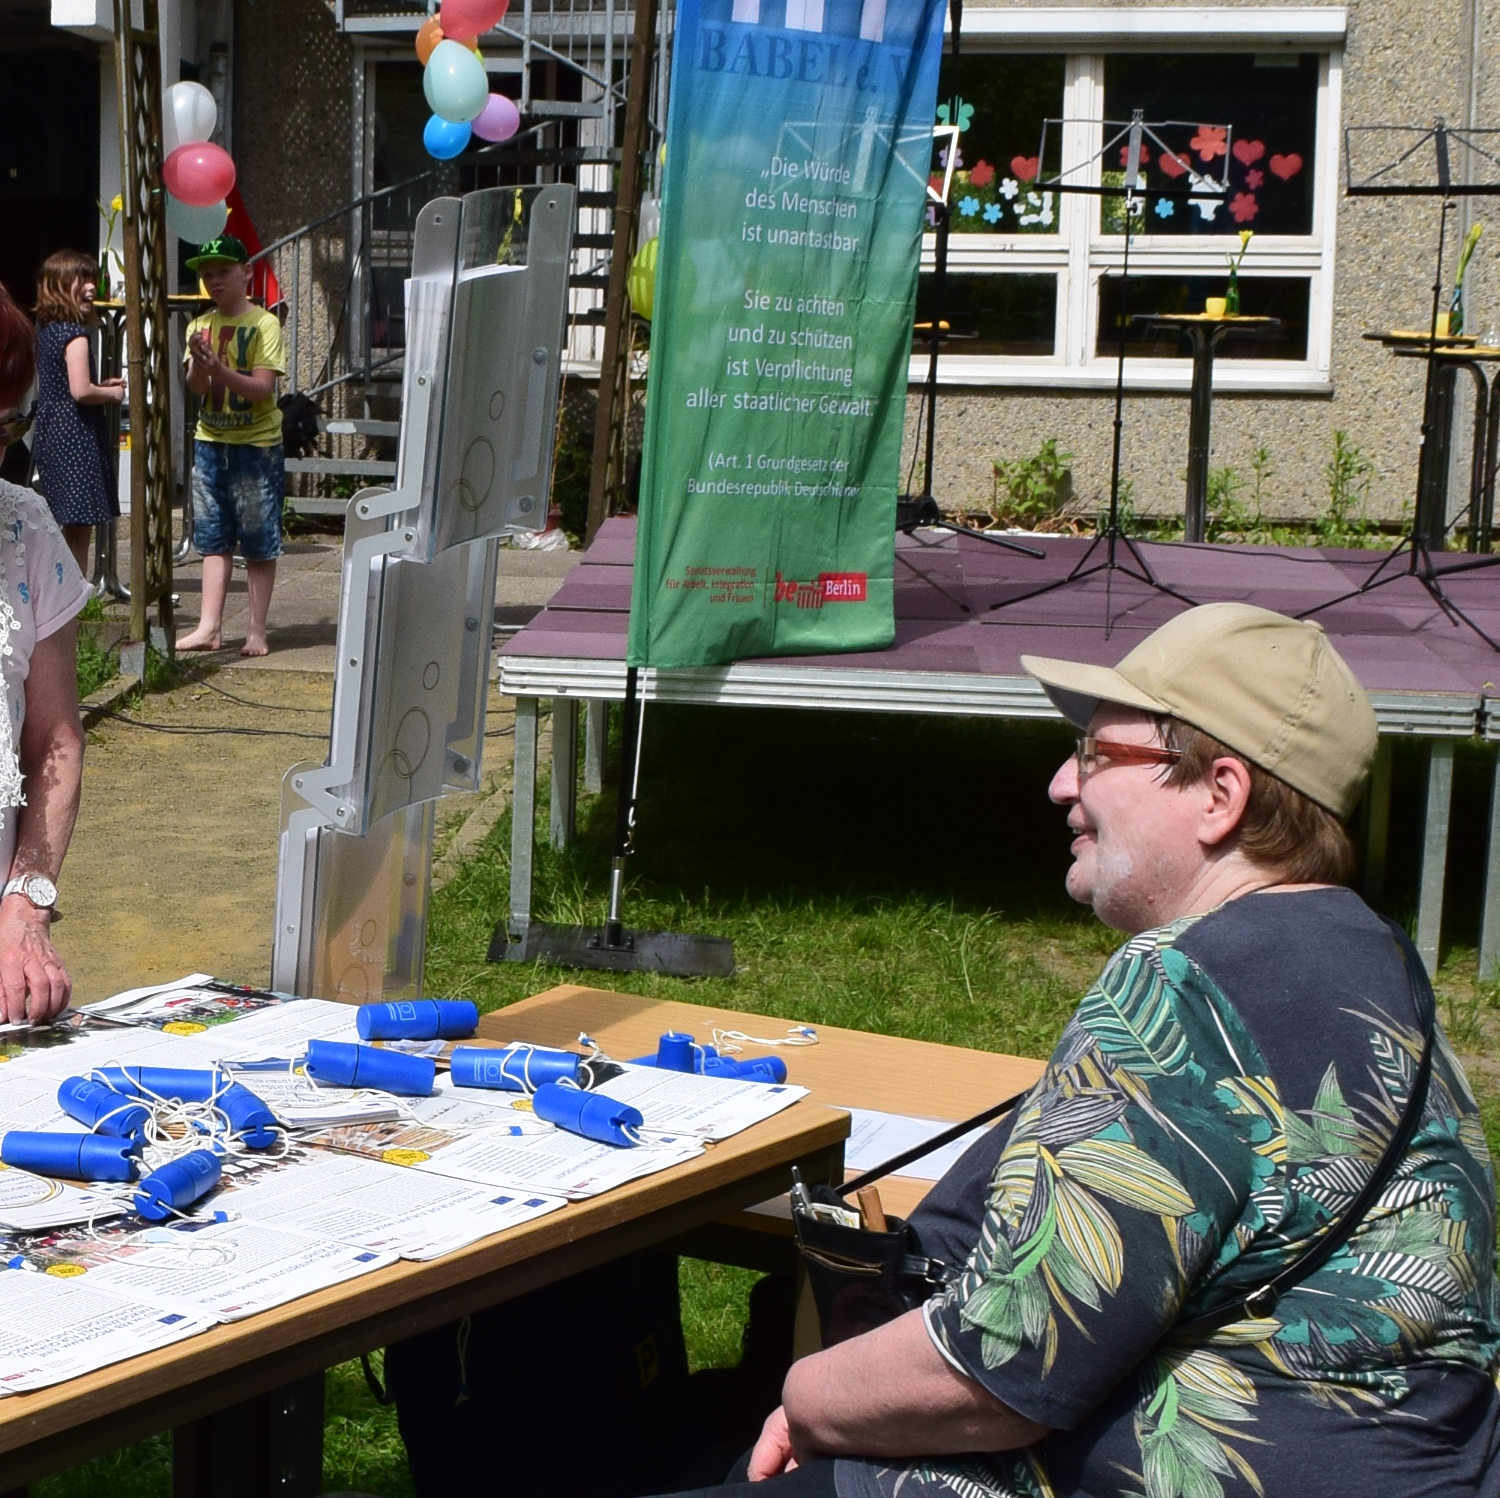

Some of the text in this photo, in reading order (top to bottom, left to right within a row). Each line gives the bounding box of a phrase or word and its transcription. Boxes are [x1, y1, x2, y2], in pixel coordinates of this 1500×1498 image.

[698, 27, 848, 87] BABEL
[804, 159, 850, 185] Würde
[745, 187, 857, 219] des Menschen
[742, 222, 762, 242] ist
[743, 289, 844, 316] Sie zu achten
[729, 324, 852, 350] und zu schützen
[726, 357, 853, 387] ist Verpflichtung
[686, 388, 727, 408] aller
[734, 391, 815, 413] staatlicher
[708, 451, 850, 474] (Art. 1 Grundgesetz der
[687, 478, 791, 498] Bundesrepublik
[685, 566, 756, 577] Senatsverwaltung
[666, 579, 754, 591] für Arbeit, Integration
[710, 593, 754, 602] und Frauen
[774, 571, 860, 602] be Berlin
